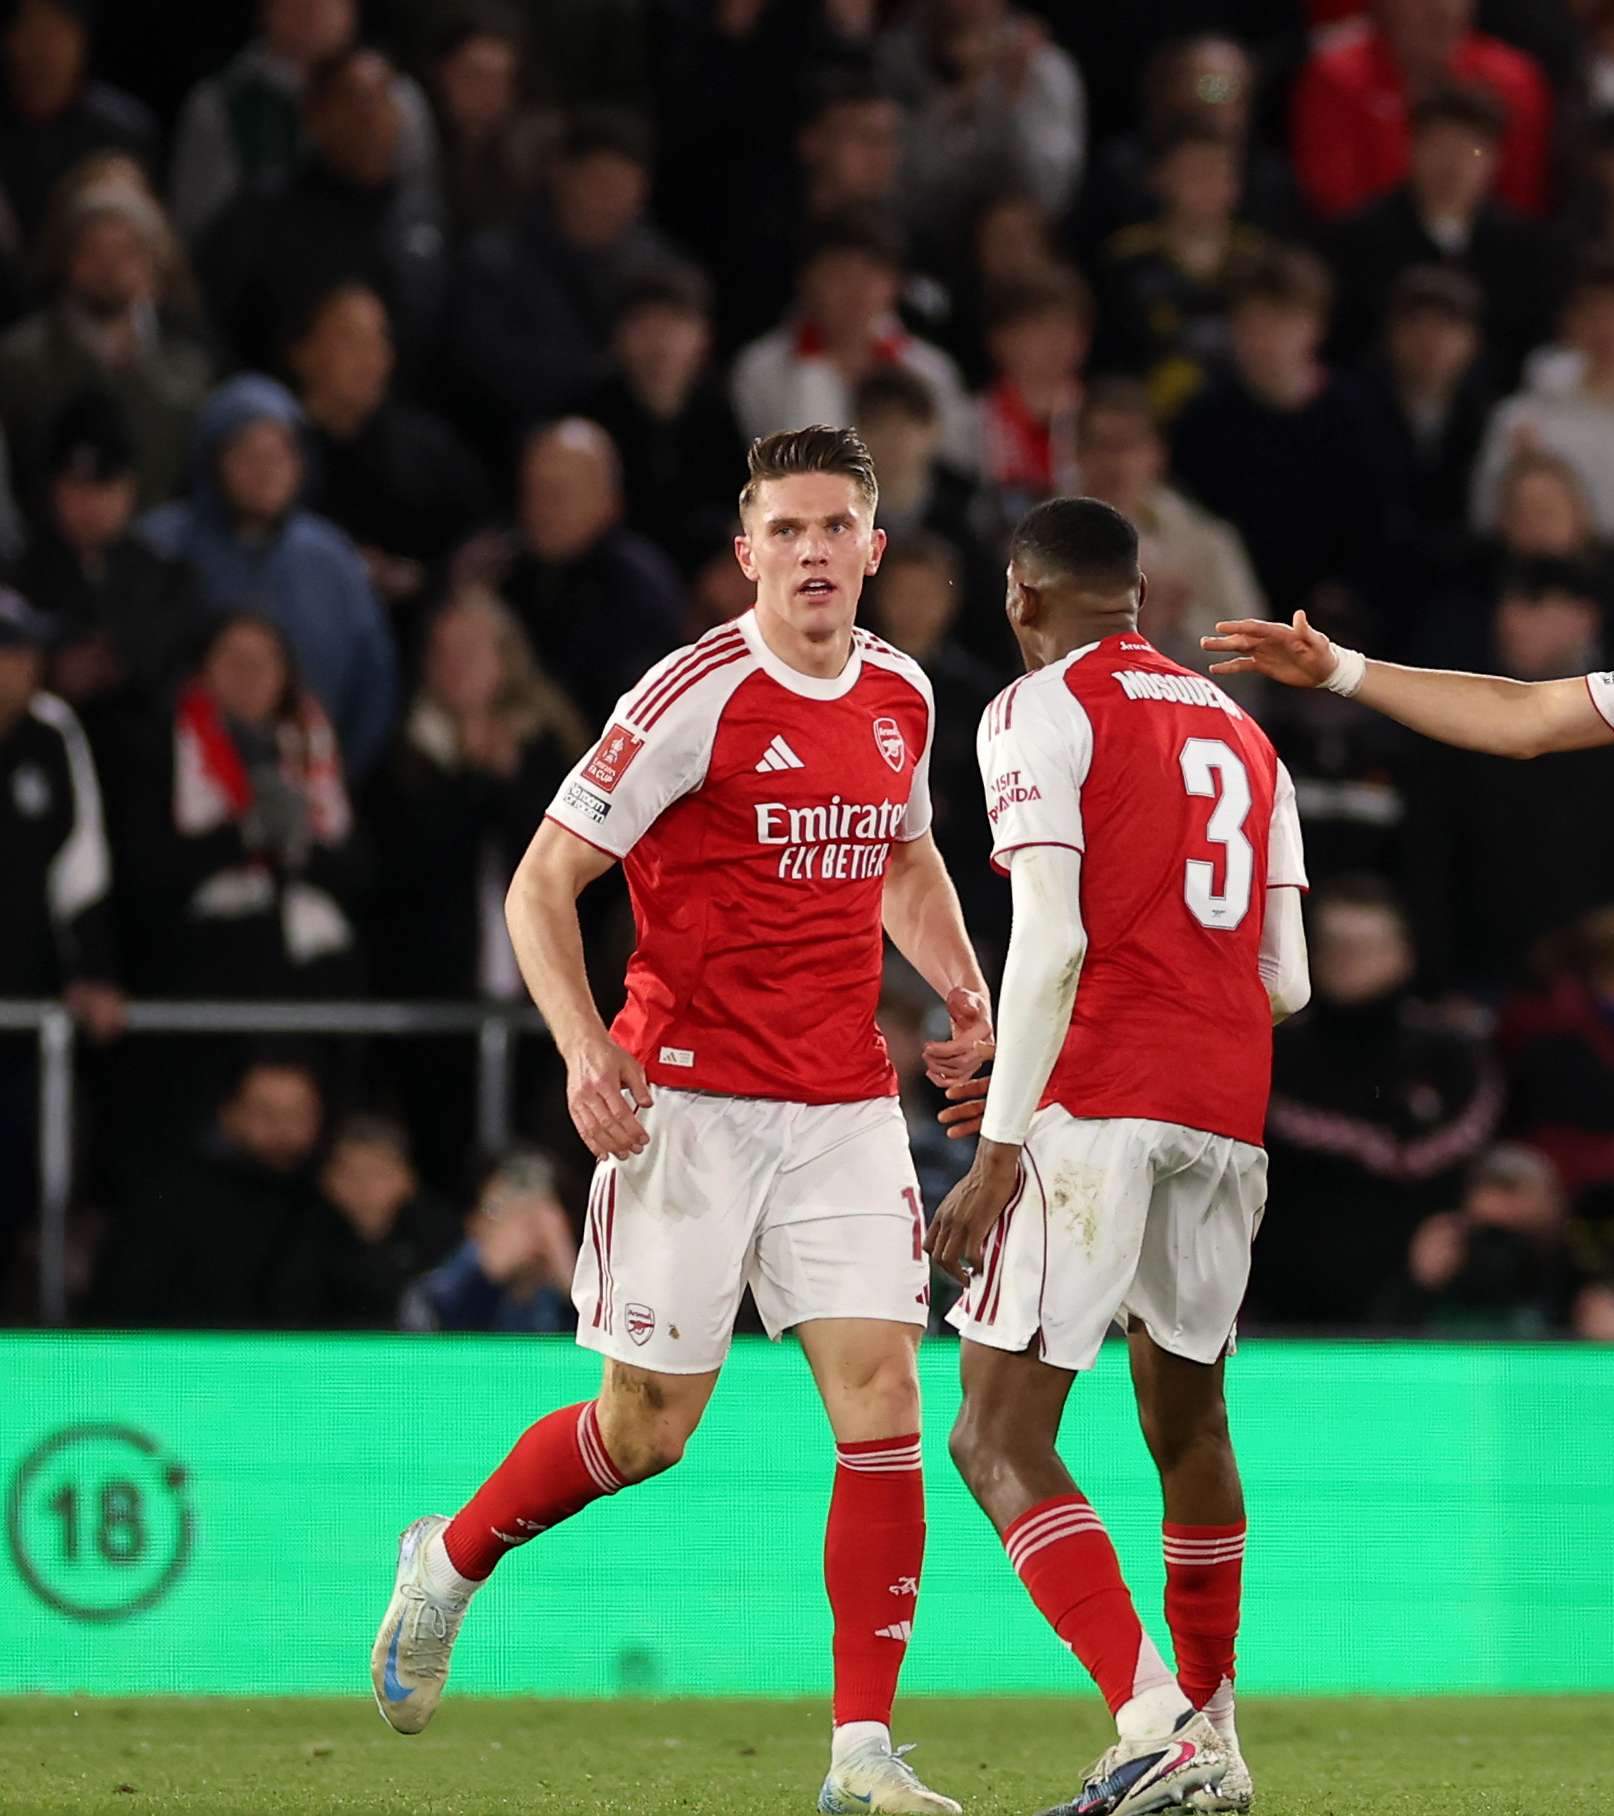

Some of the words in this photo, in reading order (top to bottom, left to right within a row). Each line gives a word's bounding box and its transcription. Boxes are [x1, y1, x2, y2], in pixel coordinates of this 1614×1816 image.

[754, 795, 908, 844] Emirate
[988, 785, 1042, 824] RANDA
[1179, 736, 1253, 931] 3
[778, 845, 820, 879] FLY
[821, 843, 890, 879] BETTER
[51, 1482, 144, 1565] 18
